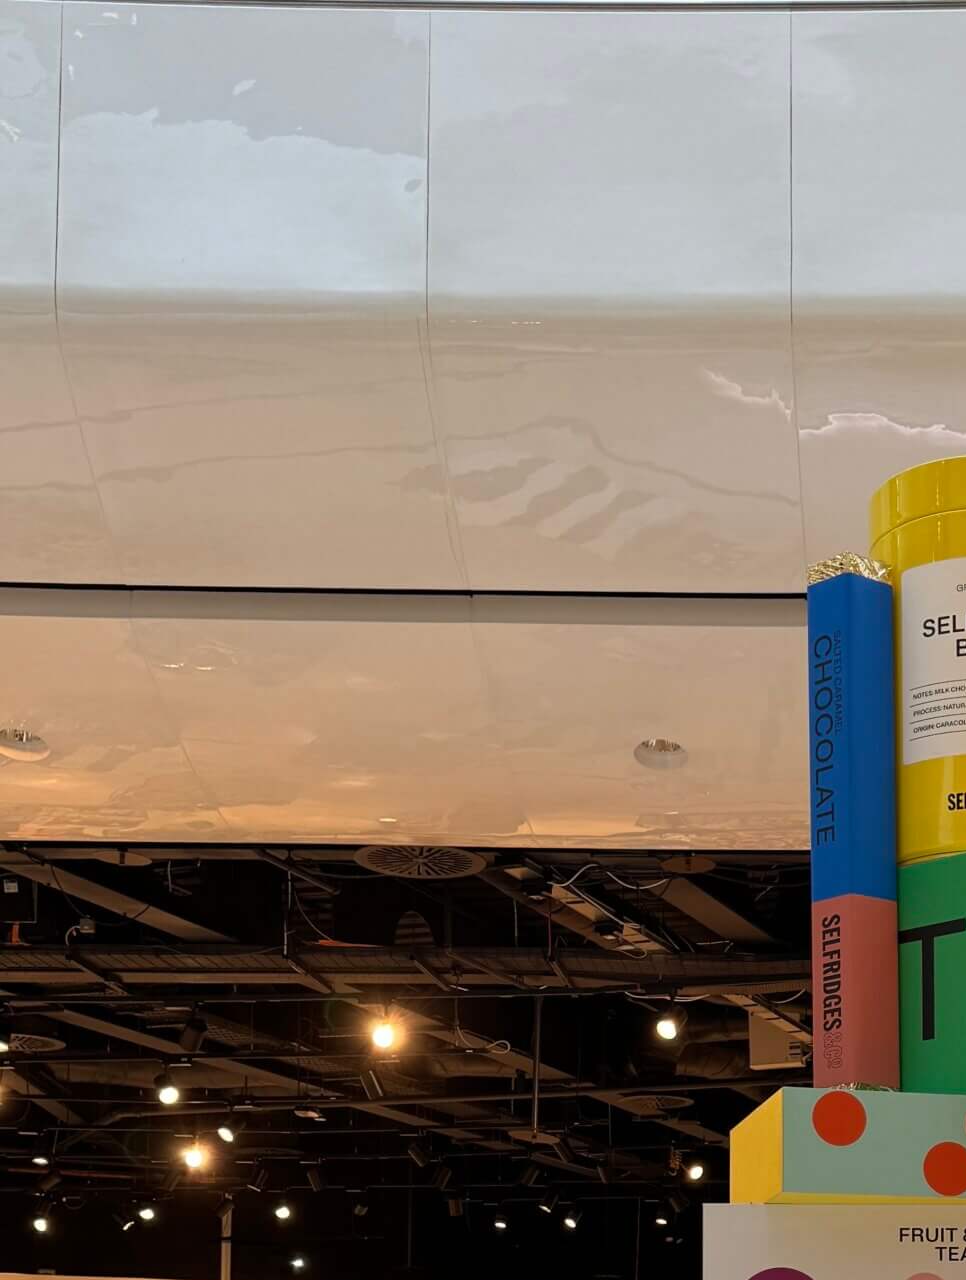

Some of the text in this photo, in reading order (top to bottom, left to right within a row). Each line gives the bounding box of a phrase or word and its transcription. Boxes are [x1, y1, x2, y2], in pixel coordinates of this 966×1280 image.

[934, 688, 950, 696] MILK
[814, 635, 836, 846] CHOCOLATE
[899, 1227, 959, 1243] FRUIT
